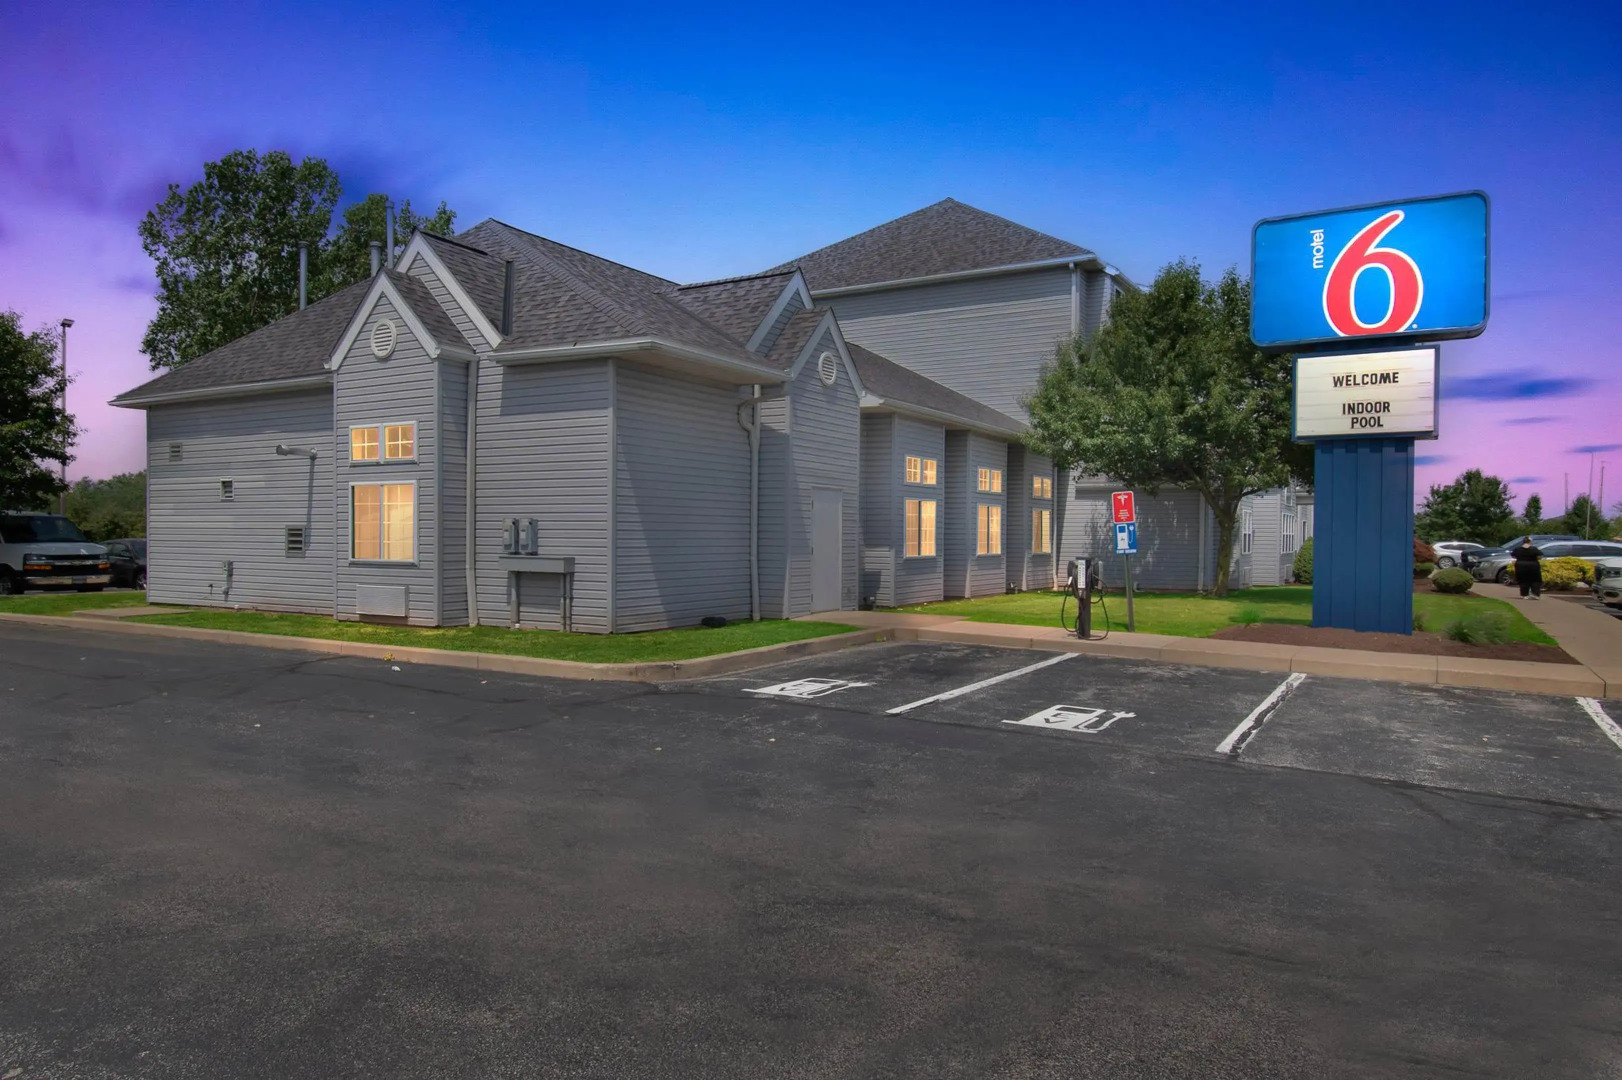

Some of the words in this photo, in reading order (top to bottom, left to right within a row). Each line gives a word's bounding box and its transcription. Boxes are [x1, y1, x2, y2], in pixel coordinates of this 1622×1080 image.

[1309, 229, 1324, 269] motel
[1322, 209, 1424, 337] 6
[1333, 372, 1399, 387] WELCOME
[1342, 401, 1390, 415] INDOOR
[1351, 416, 1384, 429] POOL
